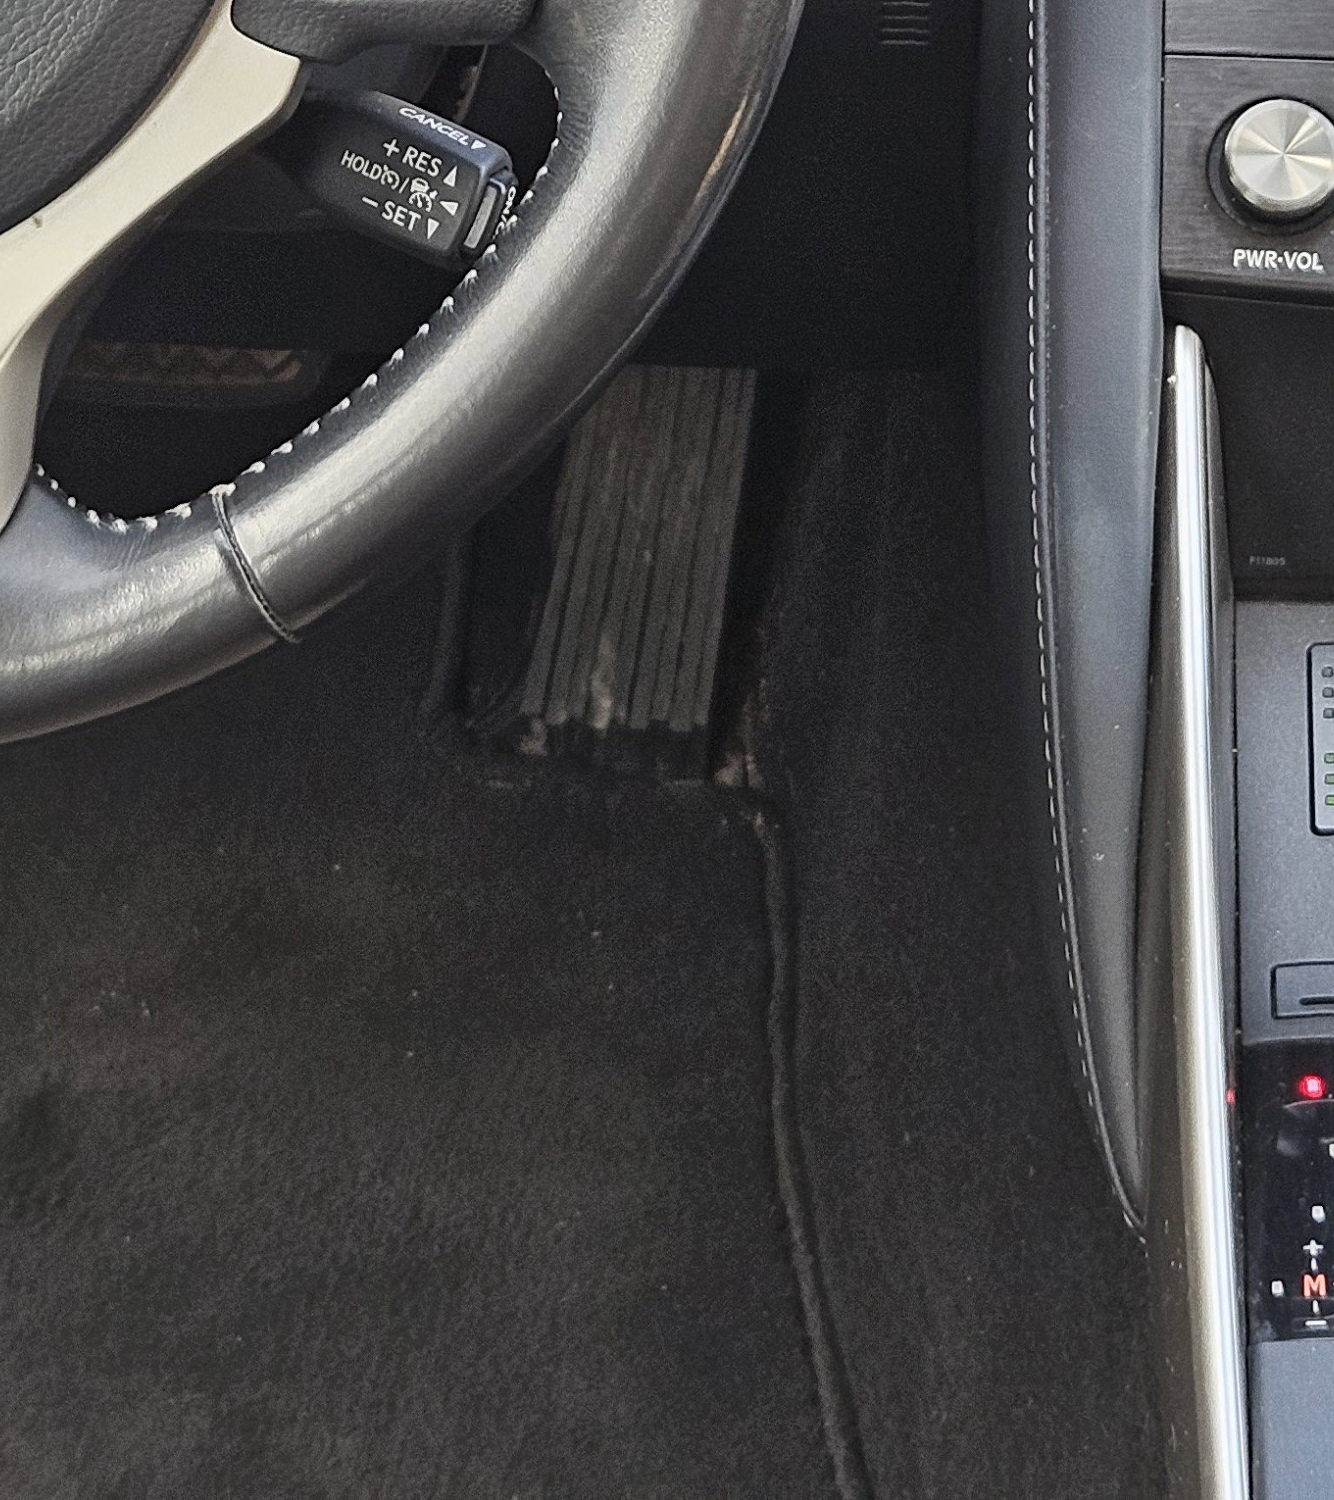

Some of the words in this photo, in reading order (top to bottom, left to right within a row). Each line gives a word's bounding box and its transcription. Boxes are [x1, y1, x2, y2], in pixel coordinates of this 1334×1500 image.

[399, 107, 469, 146] CANCEL
[341, 150, 381, 181] HOLD
[402, 147, 442, 177] RES
[381, 201, 422, 231] SET
[1303, 1274, 1327, 1297] M
